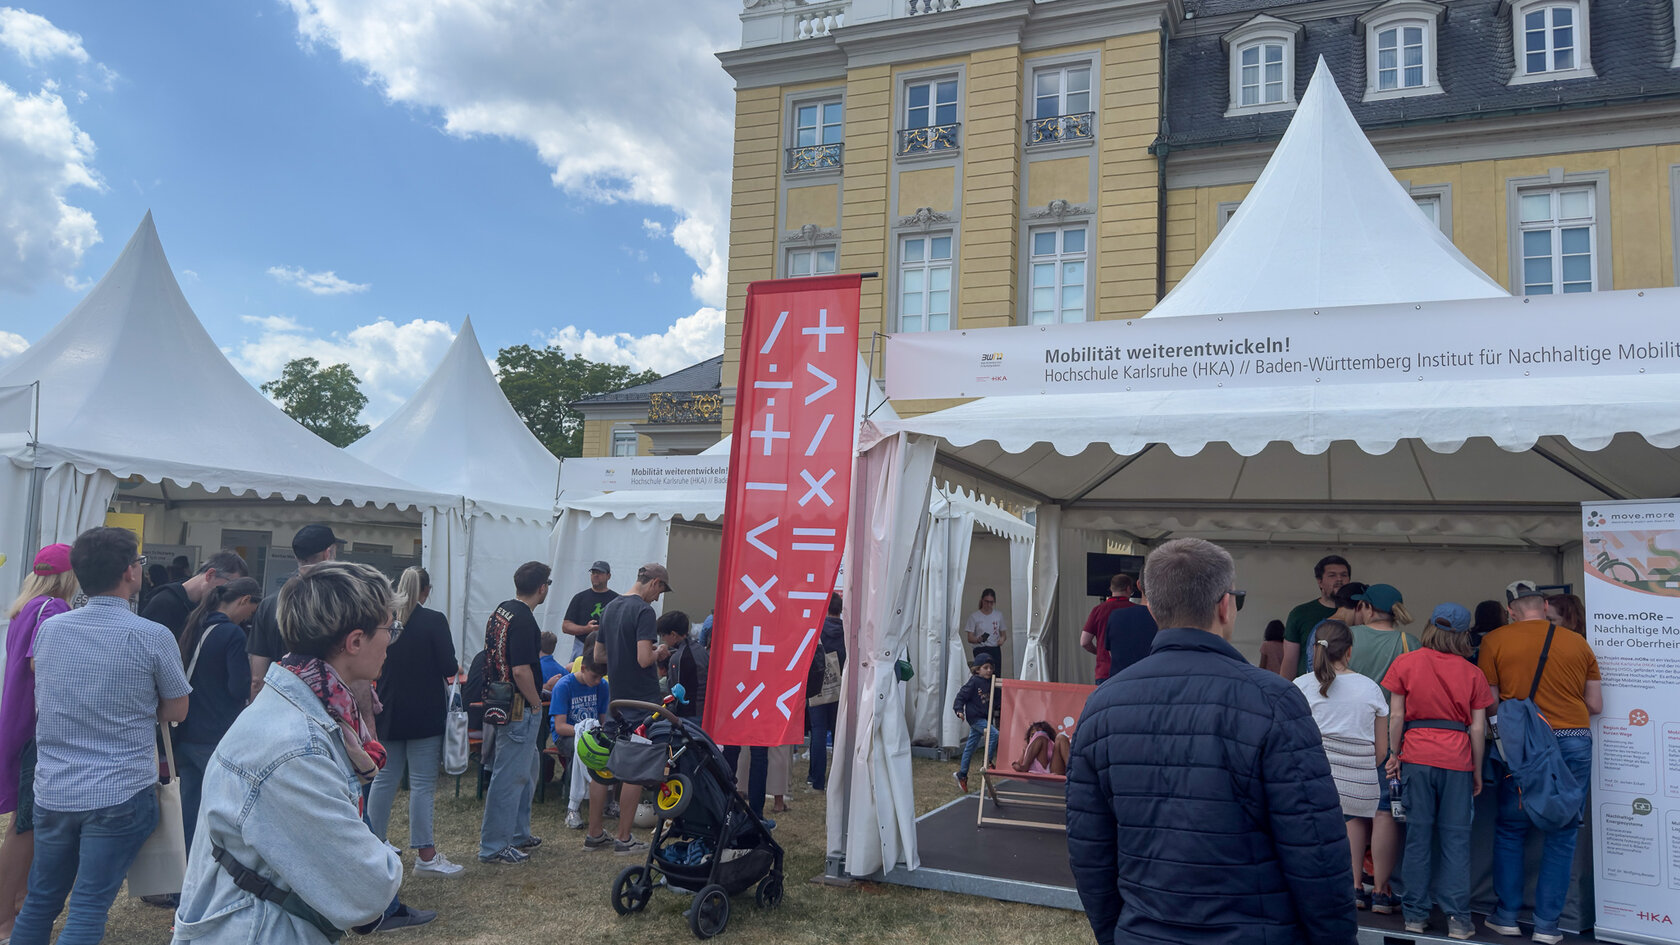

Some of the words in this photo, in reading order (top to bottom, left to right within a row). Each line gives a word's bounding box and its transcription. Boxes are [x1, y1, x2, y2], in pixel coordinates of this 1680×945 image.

[1045, 345, 1121, 363] Mobilität
[1127, 337, 1290, 360] weiterentwickeln!
[1045, 365, 1119, 382] Hochschule
[1124, 362, 1188, 380] Karlsruhe
[1193, 359, 1235, 379] (HKA)
[1256, 353, 1411, 374] Baden-Württemberg
[1418, 350, 1474, 368] Institut
[1480, 348, 1502, 366] für
[1508, 344, 1612, 366] Nachhaltige
[631, 467, 663, 476] Mobilität
[665, 466, 728, 476] weiterentwickeln!
[631, 477, 662, 485] Hochschule
[663, 477, 689, 485] Karlsruhe
[1611, 512, 1675, 520] move.more
[1593, 612, 1664, 621] move.mORe
[1594, 624, 1659, 637] Nachhaltige
[1662, 626, 1680, 635] Mo
[1594, 637, 1604, 646] in
[1606, 638, 1624, 647] der
